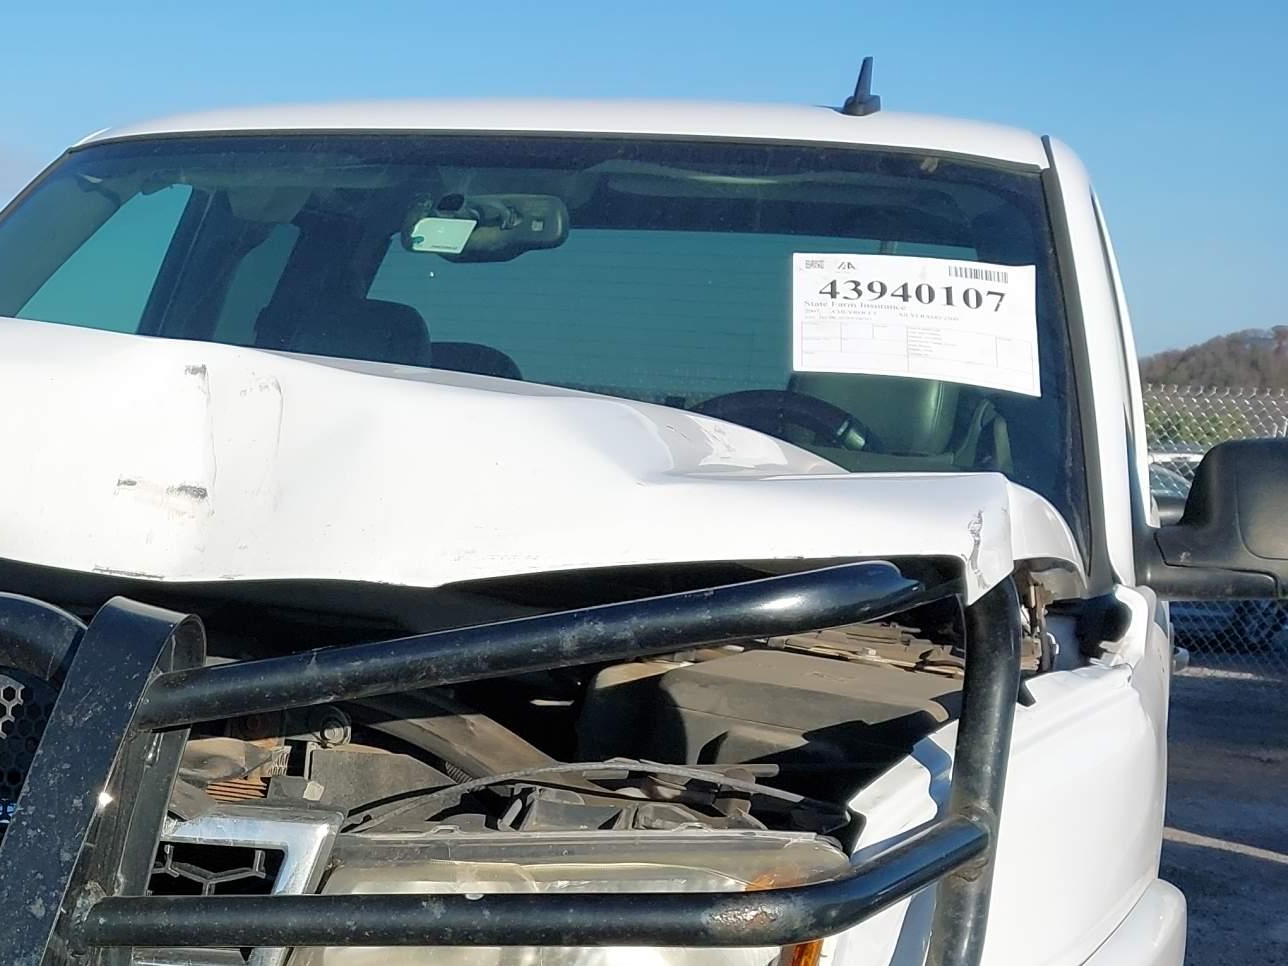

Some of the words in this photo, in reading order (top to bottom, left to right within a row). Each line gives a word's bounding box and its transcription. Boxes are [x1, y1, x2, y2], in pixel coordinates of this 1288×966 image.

[804, 300, 829, 308] State
[831, 301, 858, 309] Farm
[860, 302, 908, 311] Insurance
[819, 279, 1007, 312] 43940107
